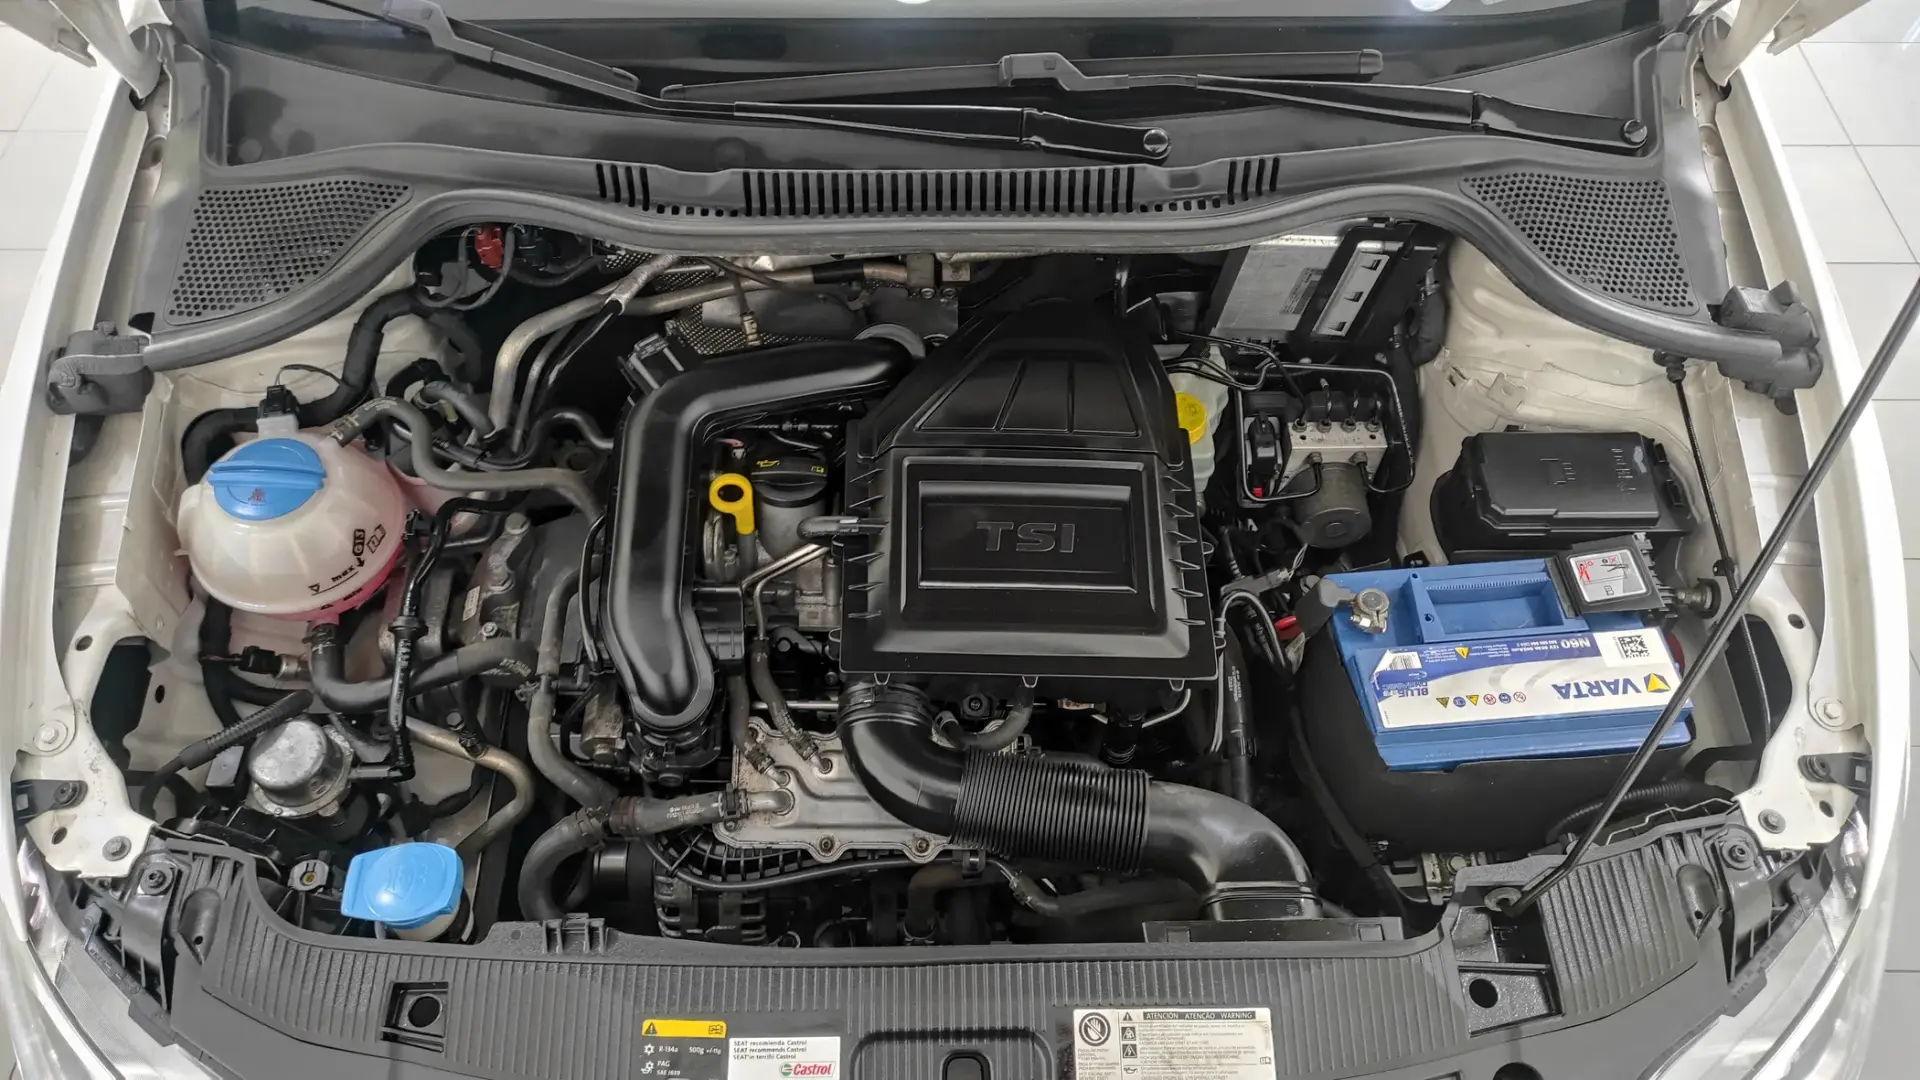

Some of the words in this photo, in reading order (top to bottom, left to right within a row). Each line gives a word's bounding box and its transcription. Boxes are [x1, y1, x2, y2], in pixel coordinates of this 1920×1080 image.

[977, 521, 1075, 552] TSI
[331, 565, 355, 582] max
[1560, 637, 1591, 649] N60
[1552, 678, 1642, 700] VARTA
[1146, 1011, 1179, 1020] ATENCIÓN
[1185, 1011, 1215, 1020] ATENÇÃO
[1220, 1011, 1252, 1019] WARNING
[658, 1045, 679, 1053] R-134a
[793, 1063, 832, 1075] Castrol
